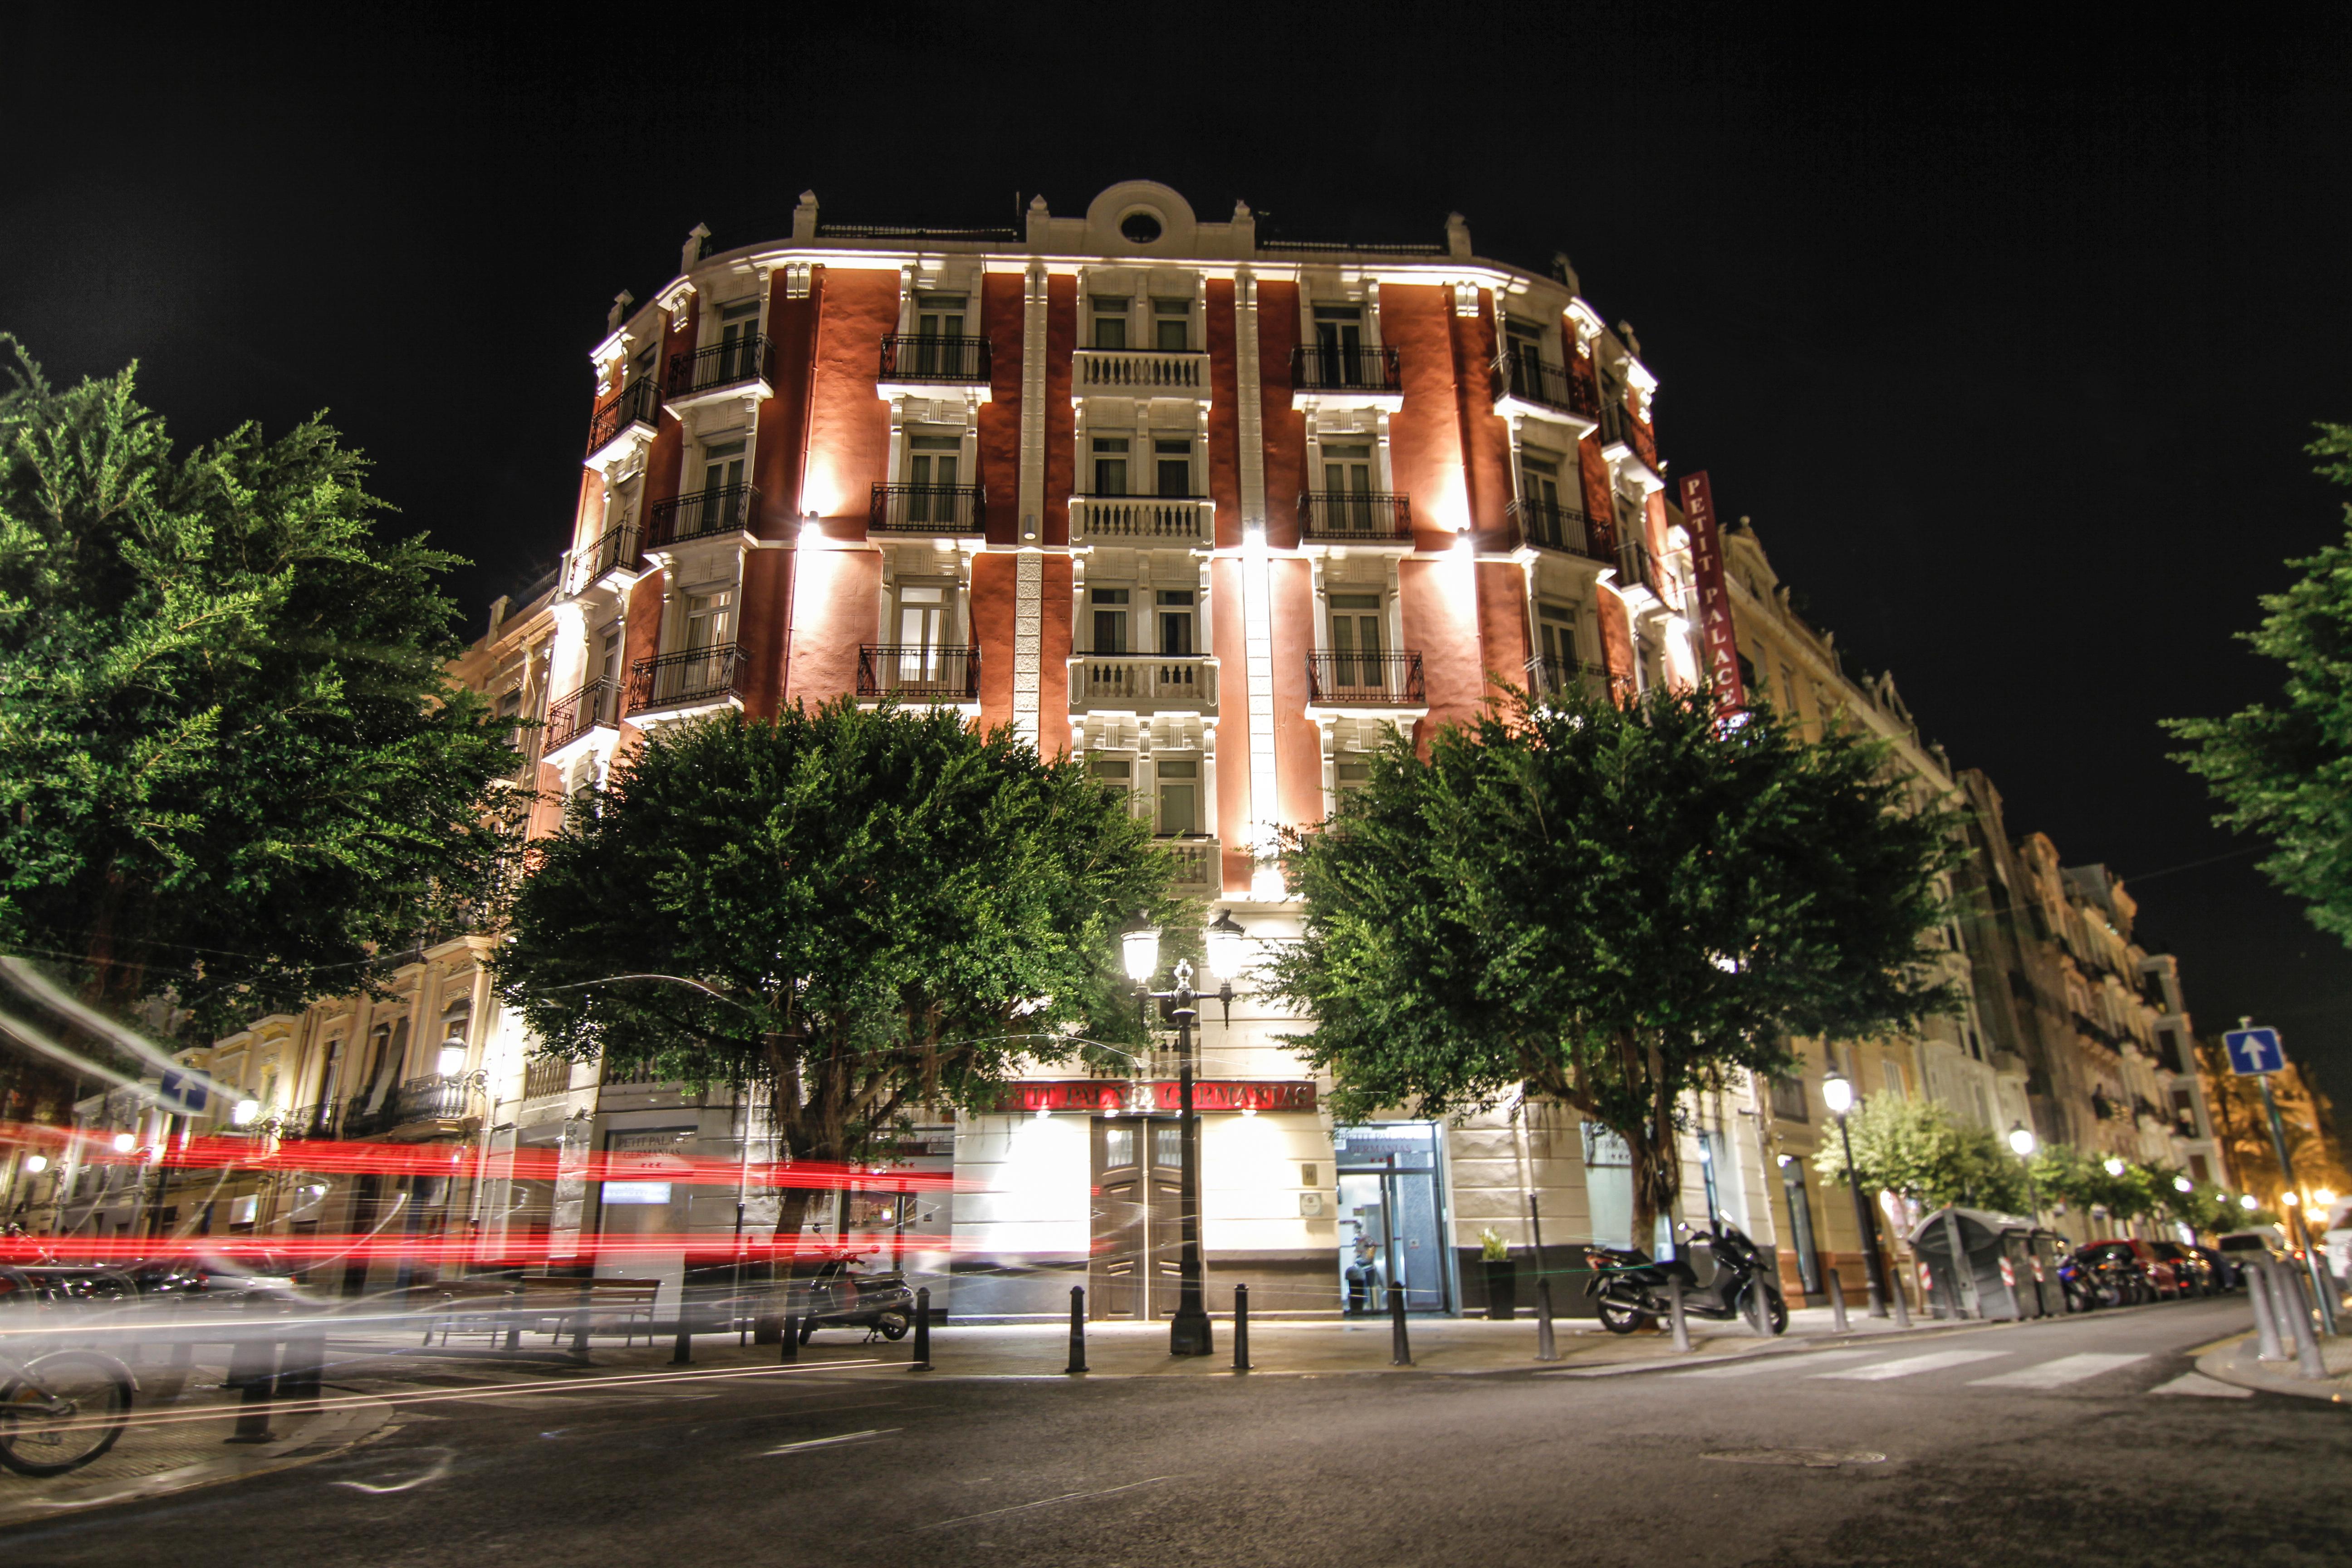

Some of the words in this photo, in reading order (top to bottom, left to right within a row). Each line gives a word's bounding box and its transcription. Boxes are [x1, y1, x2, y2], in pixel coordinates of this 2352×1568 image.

[1687, 477, 1713, 573] PETIT
[1705, 587, 1736, 706] PALACE
[997, 1086, 1056, 1106] ETIT
[1066, 1086, 1156, 1106] PALACE
[1164, 1086, 1307, 1106] GRMANIAS
[618, 1137, 647, 1147] PETIT
[648, 1136, 689, 1147] PALACE
